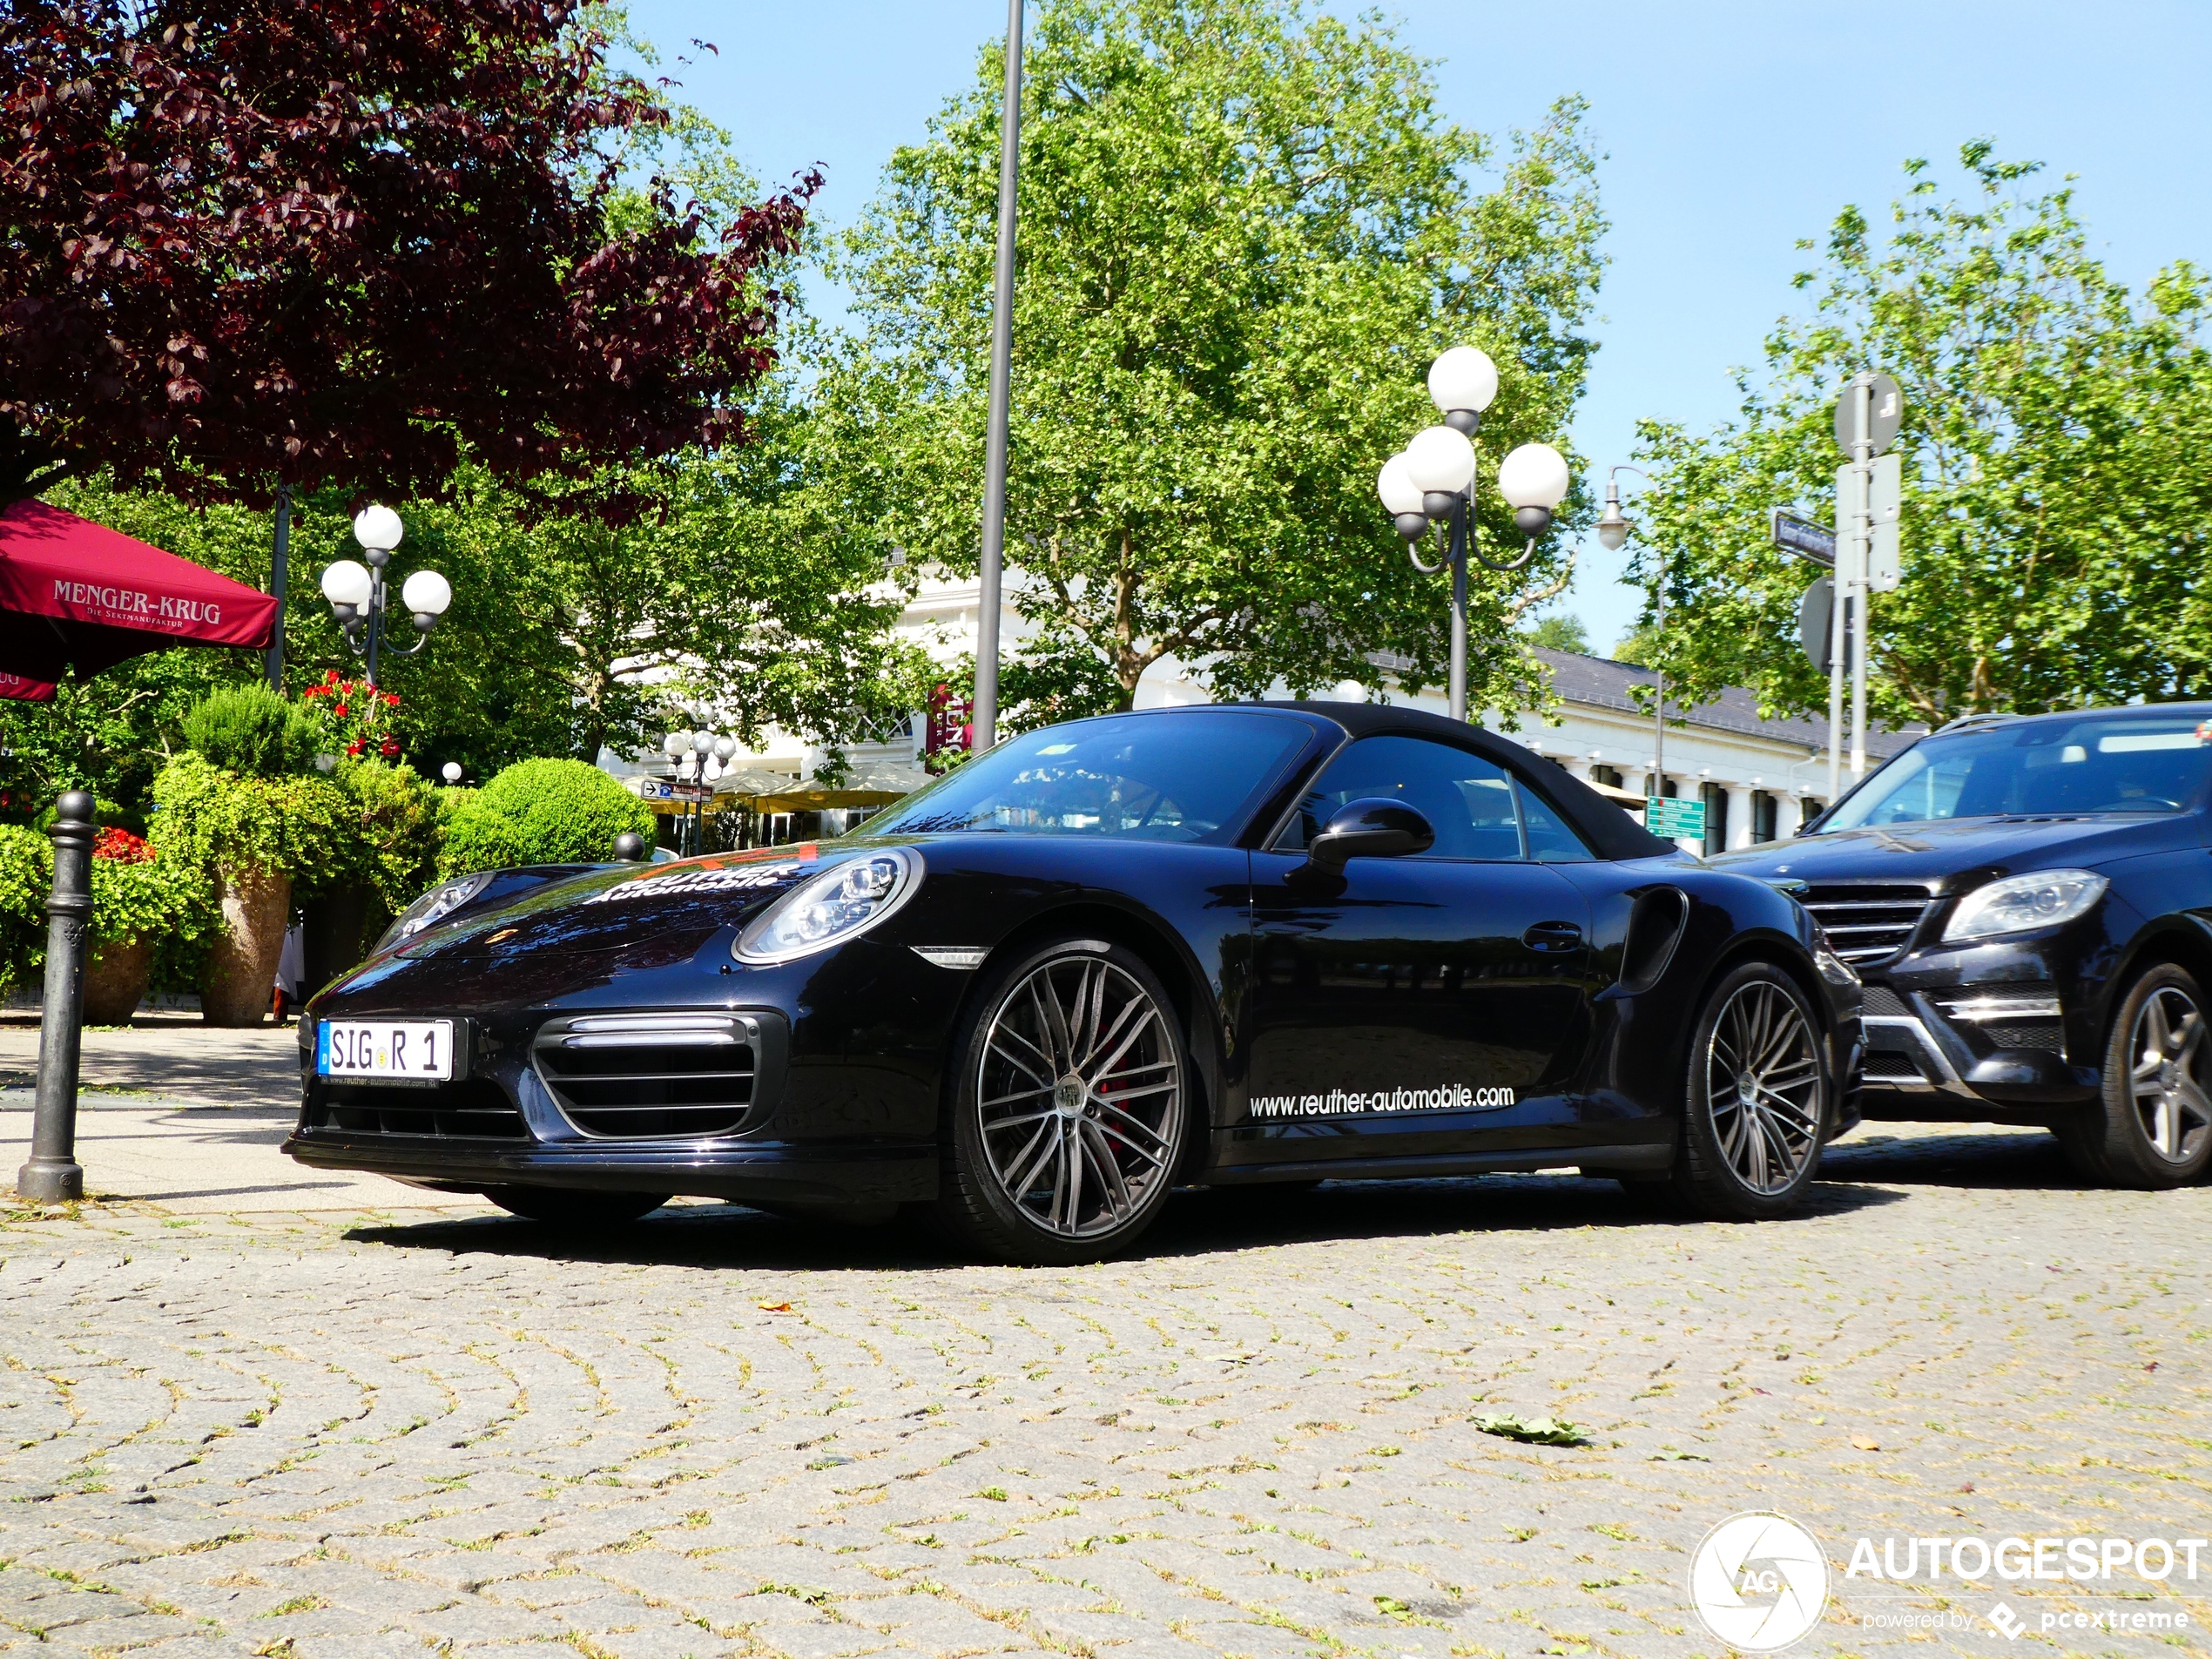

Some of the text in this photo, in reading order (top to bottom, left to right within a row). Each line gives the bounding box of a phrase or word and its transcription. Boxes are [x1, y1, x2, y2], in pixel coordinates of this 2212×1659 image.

[54, 580, 221, 624] MENGER-KRUG
[581, 876, 778, 906] Automobile
[608, 863, 800, 894] REUTHER
[332, 1029, 372, 1069] SIG
[392, 1030, 407, 1070] R
[423, 1030, 438, 1071] 1
[1251, 1083, 1514, 1116] www.reuther-automobile.com
